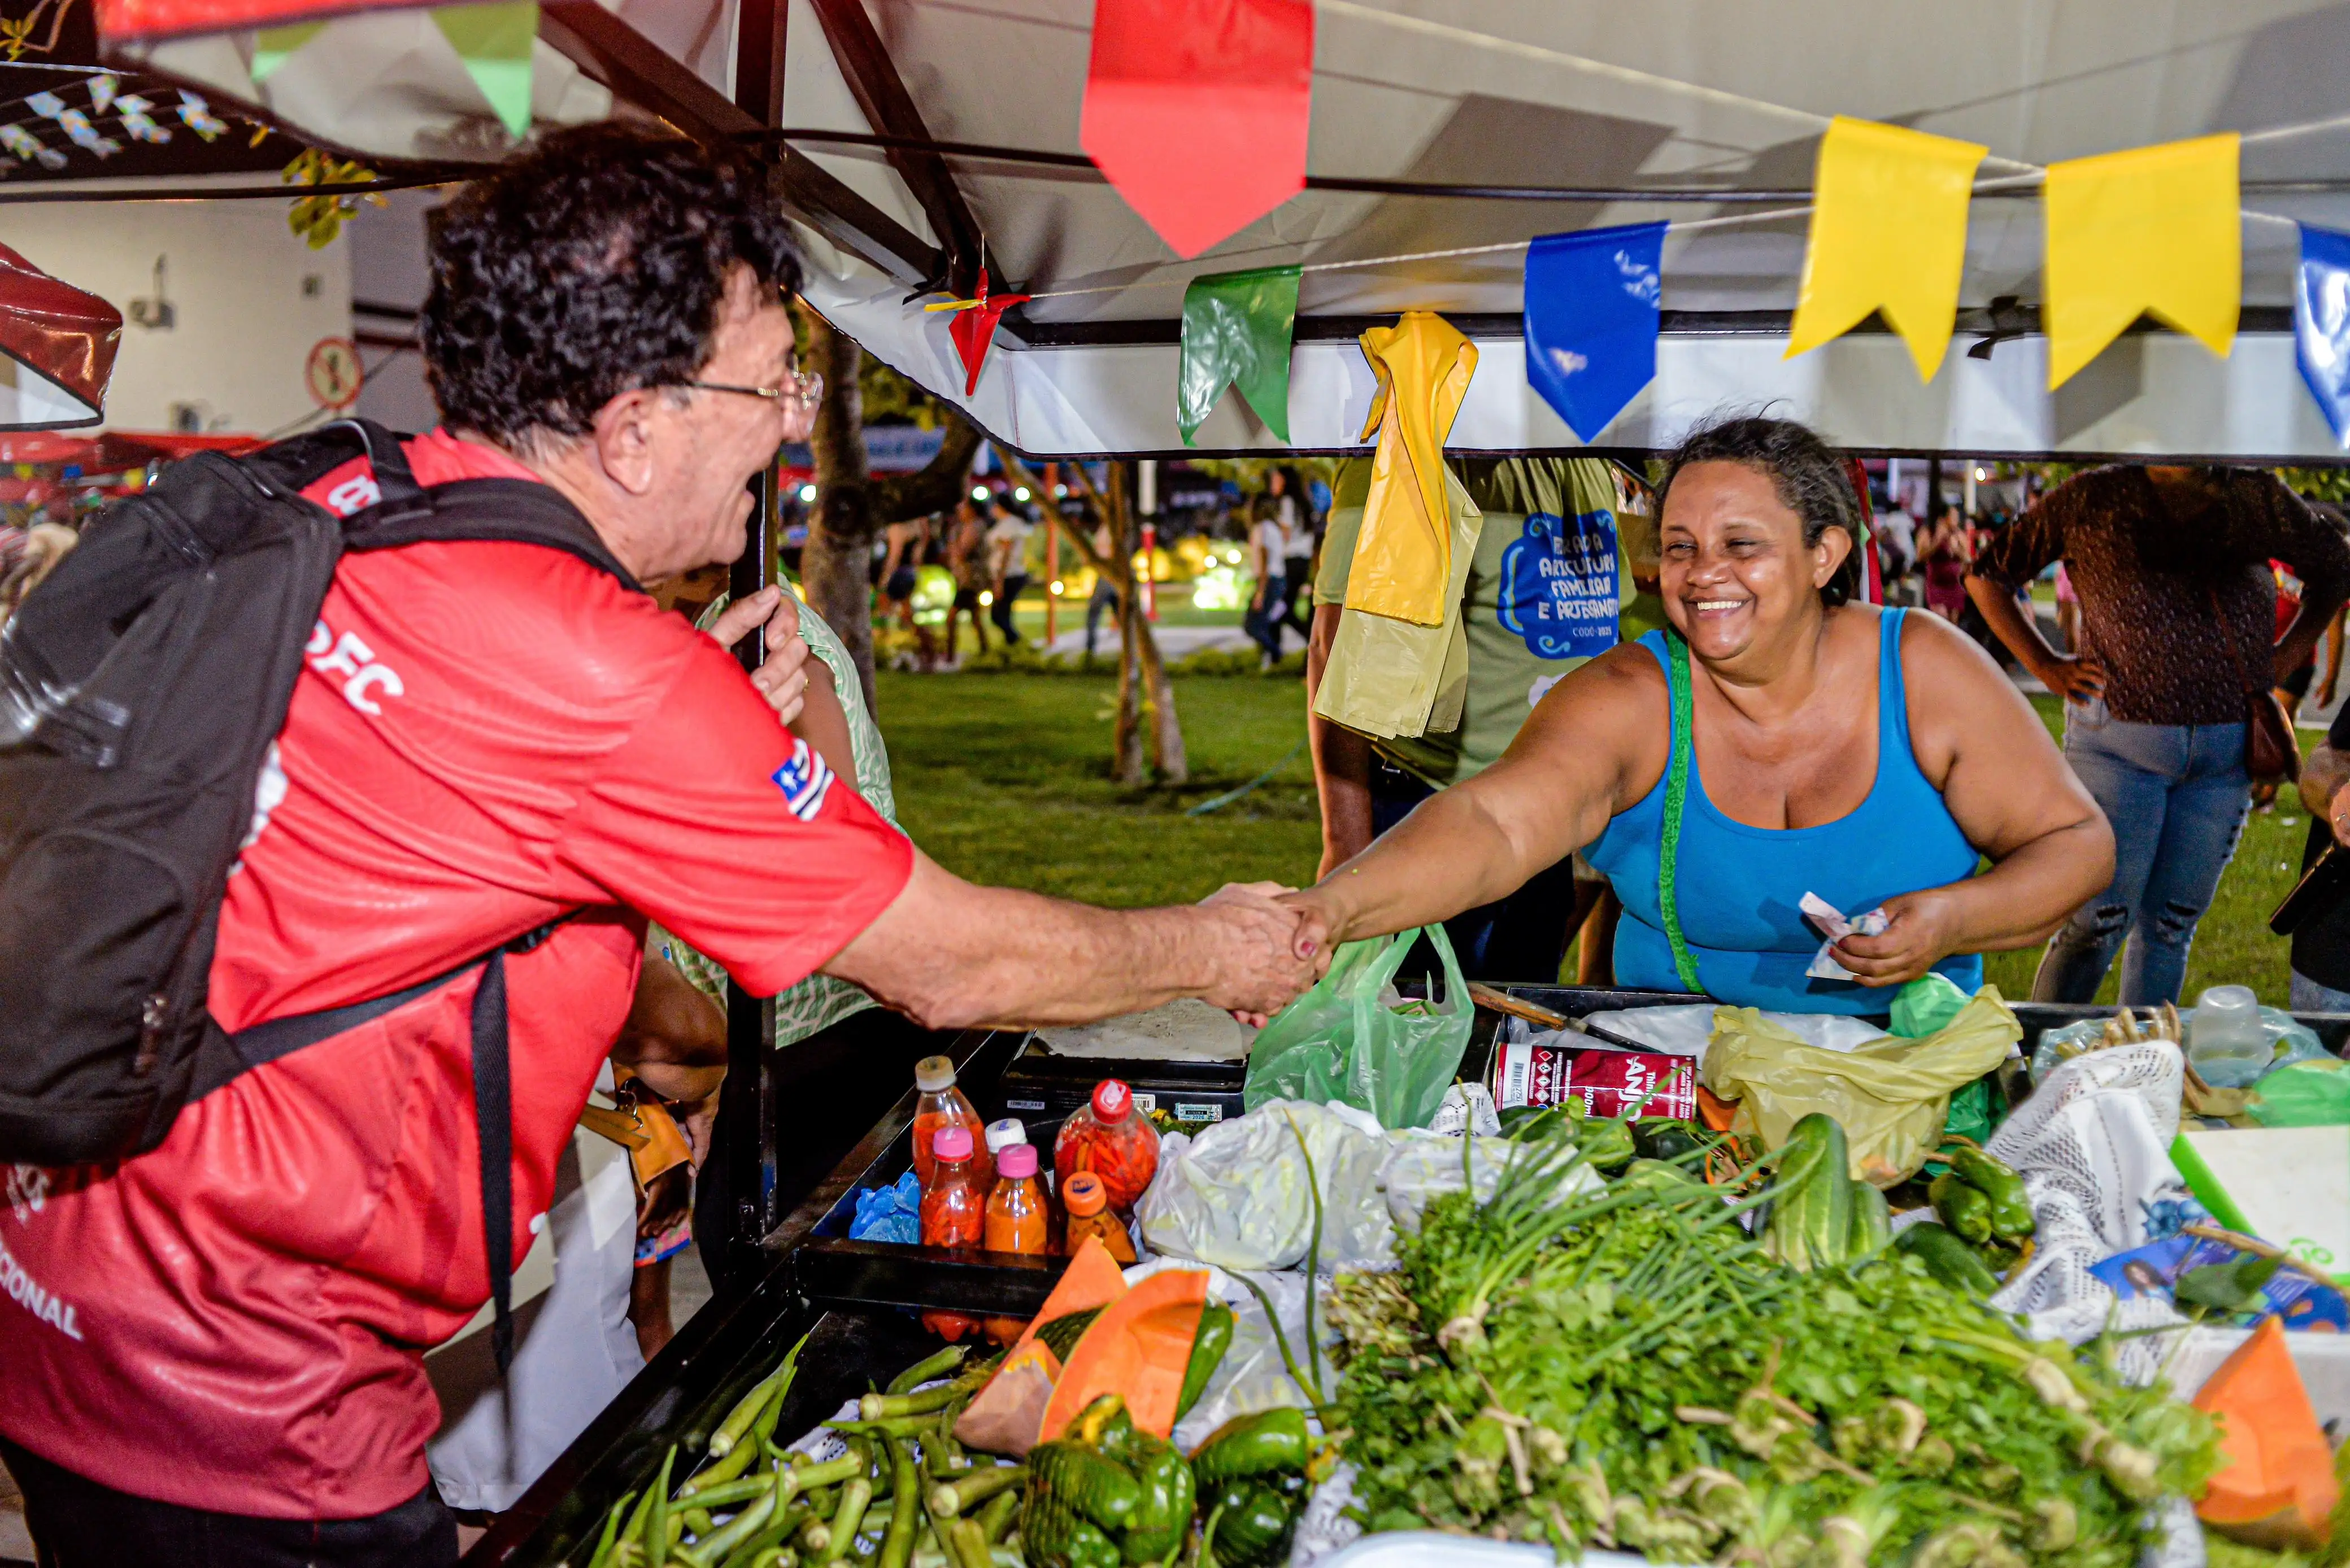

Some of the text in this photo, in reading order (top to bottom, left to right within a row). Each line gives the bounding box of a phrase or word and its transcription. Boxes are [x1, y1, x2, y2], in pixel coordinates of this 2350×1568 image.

[1538, 598, 1619, 620] E ARTESANAT
[1551, 577, 1611, 598] FAMILIAR
[1618, 1056, 1646, 1122] ANJO
[0, 1247, 85, 1341] CIONAL
